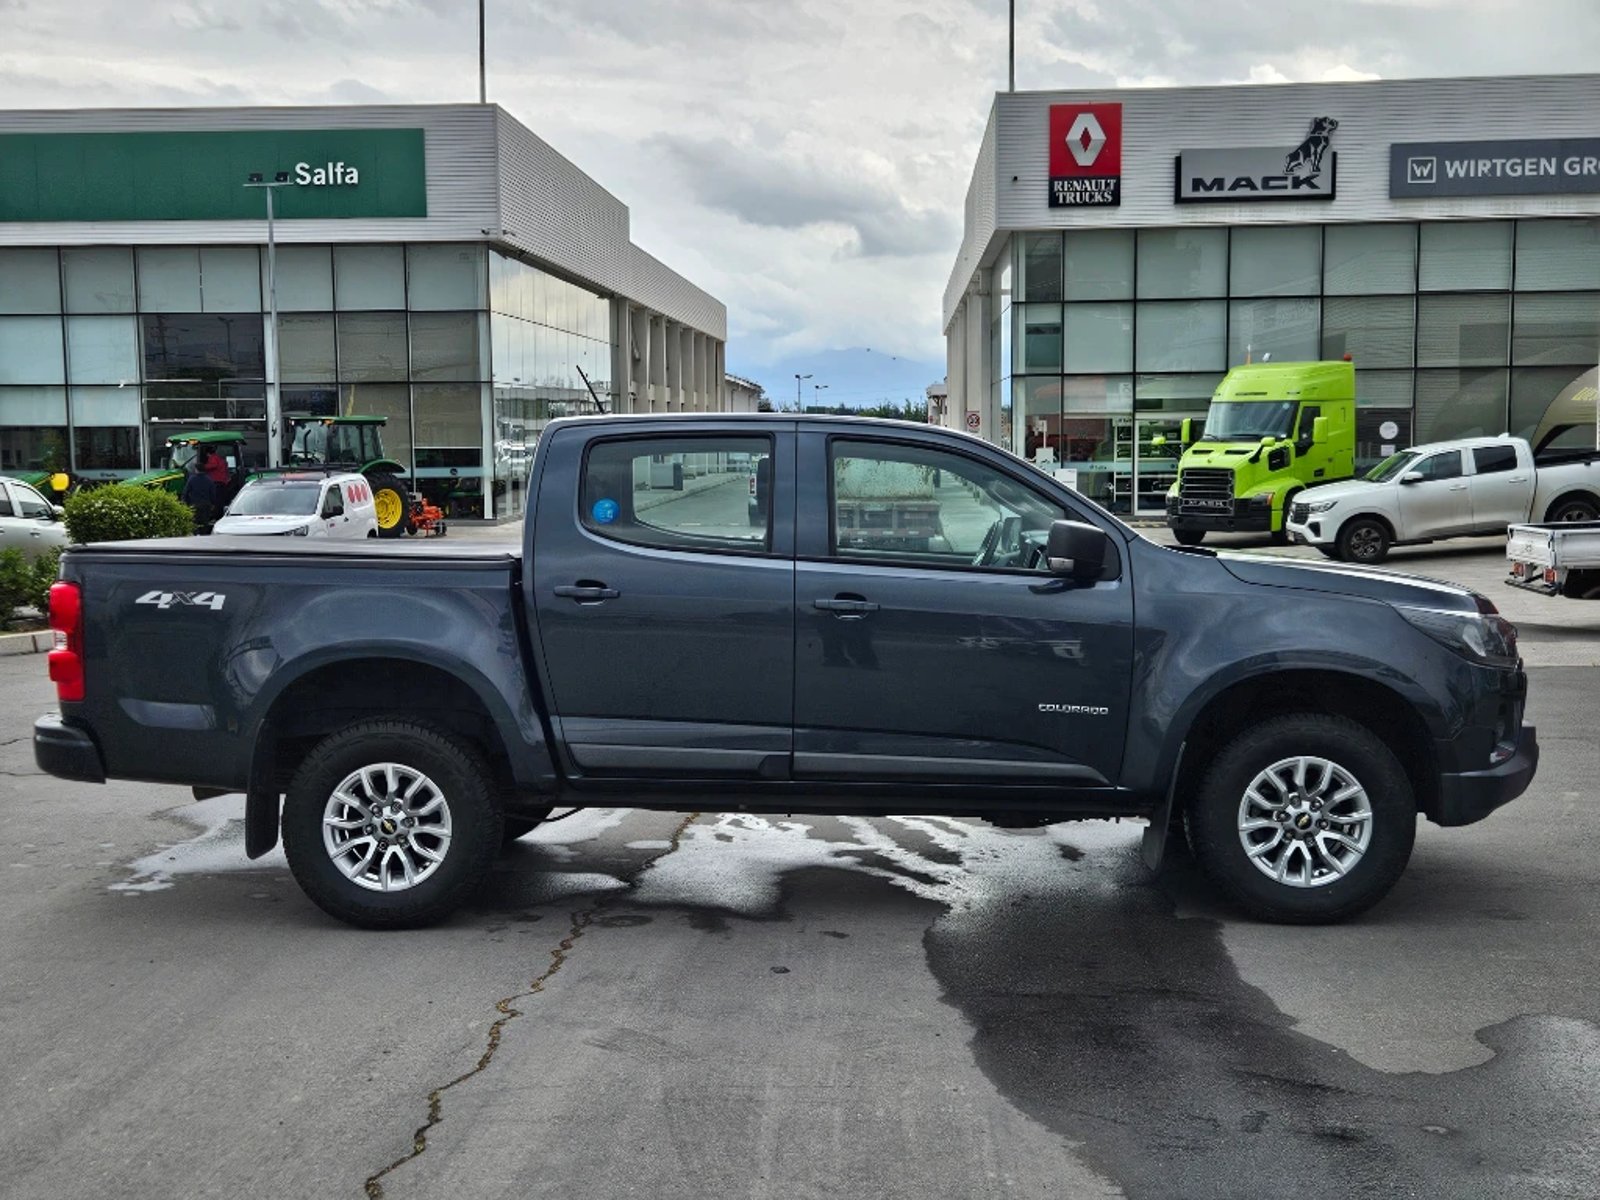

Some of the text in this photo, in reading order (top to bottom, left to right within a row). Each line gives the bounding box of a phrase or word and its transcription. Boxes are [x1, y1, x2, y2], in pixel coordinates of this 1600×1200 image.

[295, 161, 359, 185] Salfa
[1444, 157, 1557, 178] WIRTGEN
[1563, 156, 1600, 176] GR
[1053, 179, 1117, 192] RENAULT
[1191, 174, 1320, 193] MACK
[1055, 191, 1113, 204] TRUCKS
[1038, 703, 1109, 715] COLORADO
